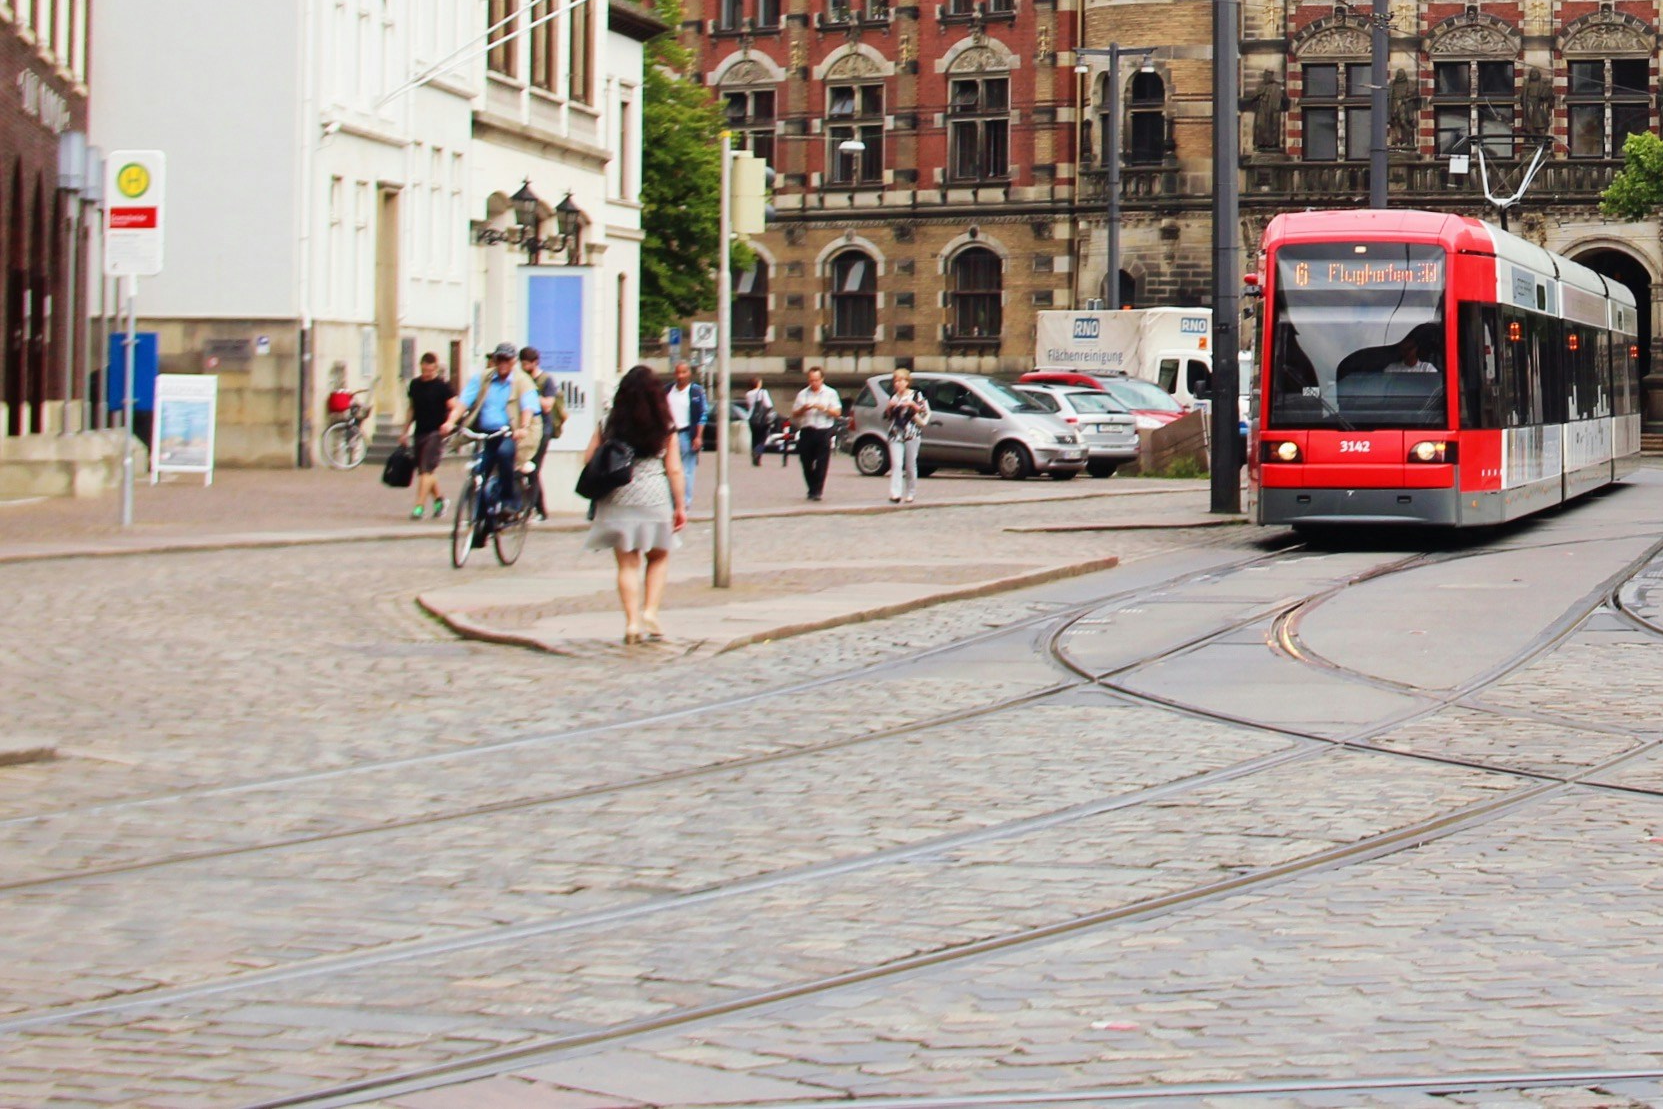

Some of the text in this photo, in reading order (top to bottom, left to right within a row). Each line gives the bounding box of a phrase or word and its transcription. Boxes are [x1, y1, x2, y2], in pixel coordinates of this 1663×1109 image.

[1296, 262, 1309, 287] 6
[1074, 318, 1099, 337] RNO
[1182, 317, 1207, 332] RNO
[1048, 349, 1124, 365] Flächenreinigung
[1340, 440, 1371, 453] 3142
